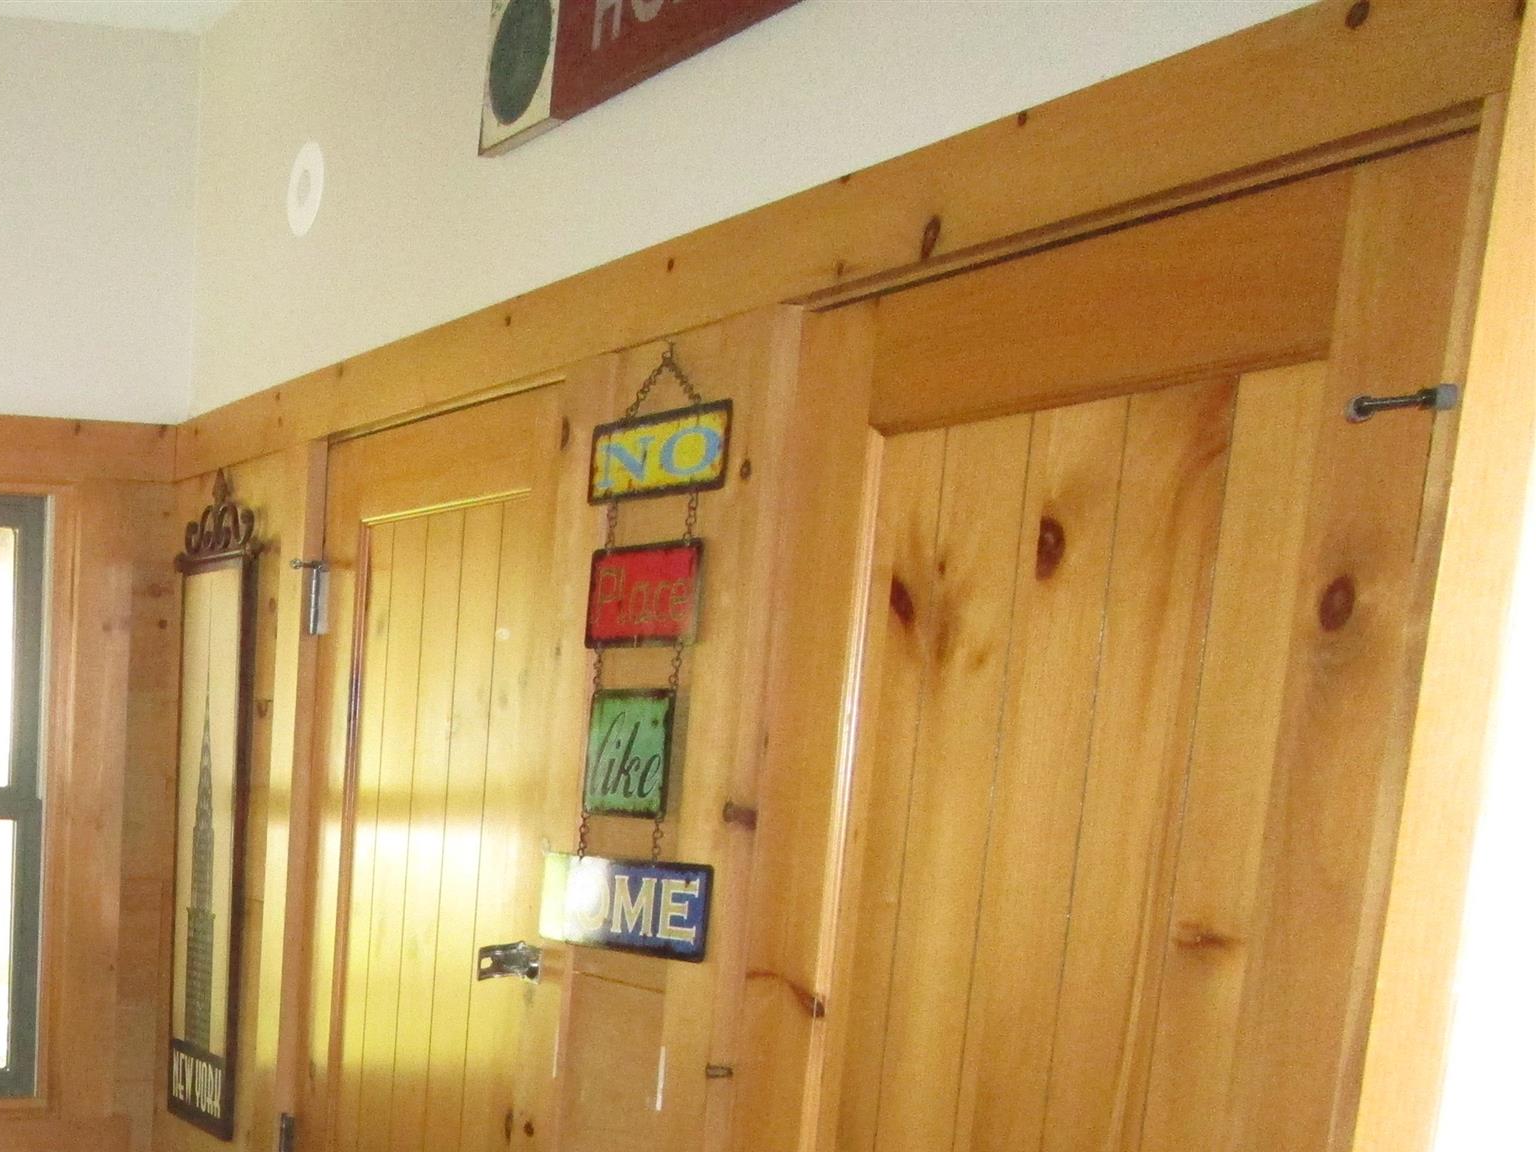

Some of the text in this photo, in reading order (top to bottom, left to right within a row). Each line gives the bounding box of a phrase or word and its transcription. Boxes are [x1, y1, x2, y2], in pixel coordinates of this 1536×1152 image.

[595, 426, 721, 489] NO
[591, 566, 690, 625] Place
[589, 711, 661, 798] like
[550, 874, 700, 945] OME
[172, 1048, 222, 1119] NEW YORK
